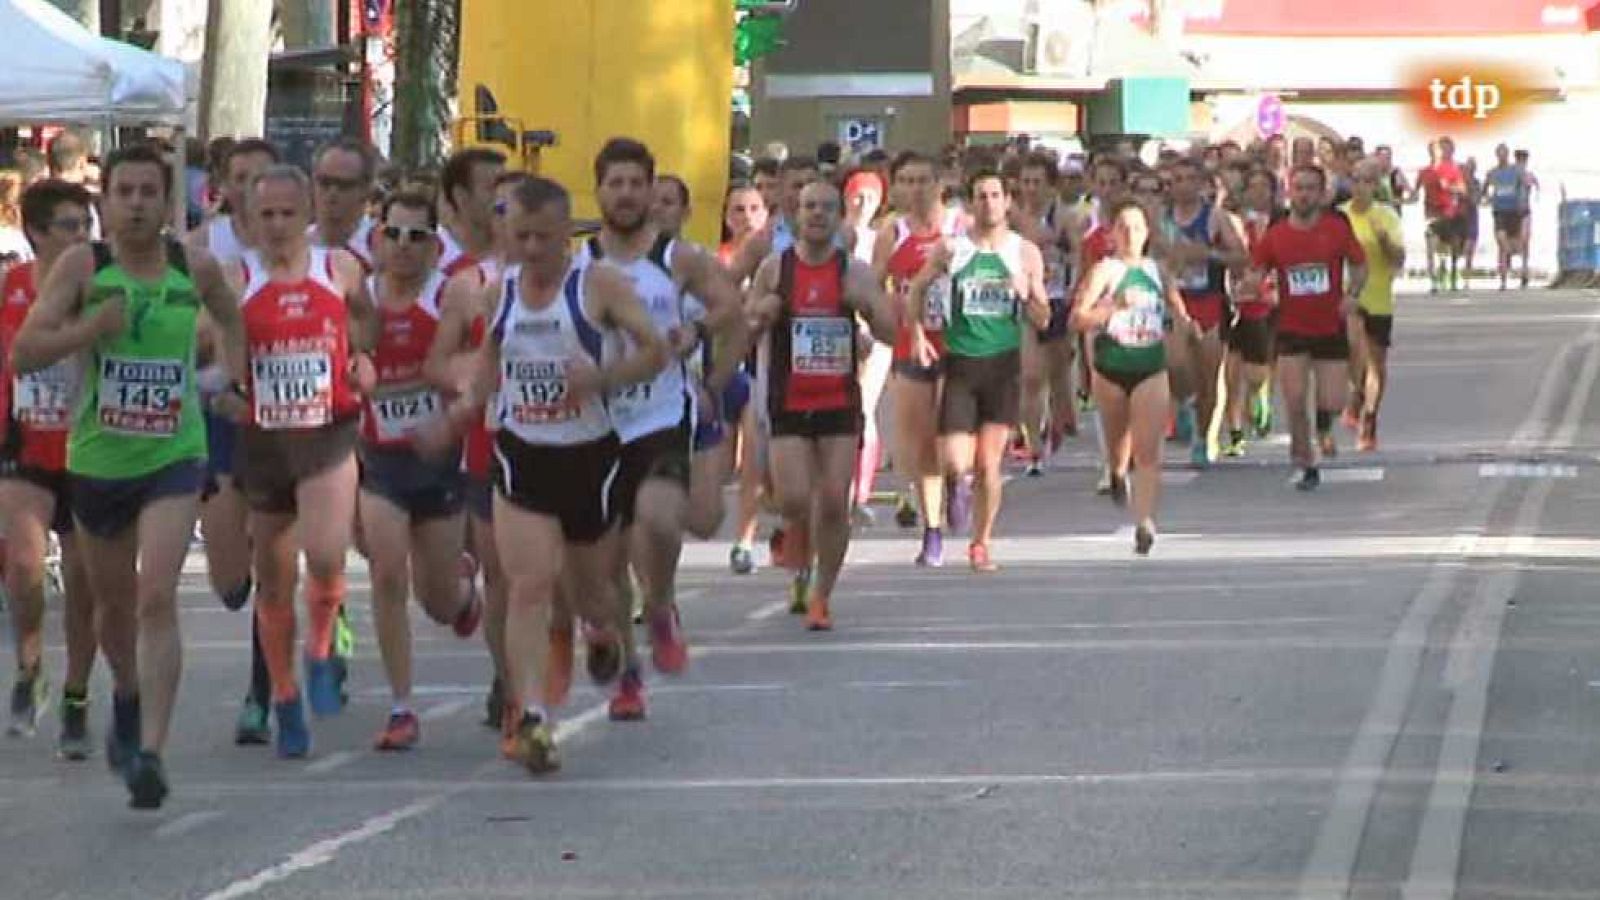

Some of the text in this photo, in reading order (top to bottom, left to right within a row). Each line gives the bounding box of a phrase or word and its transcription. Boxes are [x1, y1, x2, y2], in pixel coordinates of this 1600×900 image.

[118, 381, 169, 410] 143
[379, 394, 436, 419] 1021
[521, 383, 565, 405] 192
